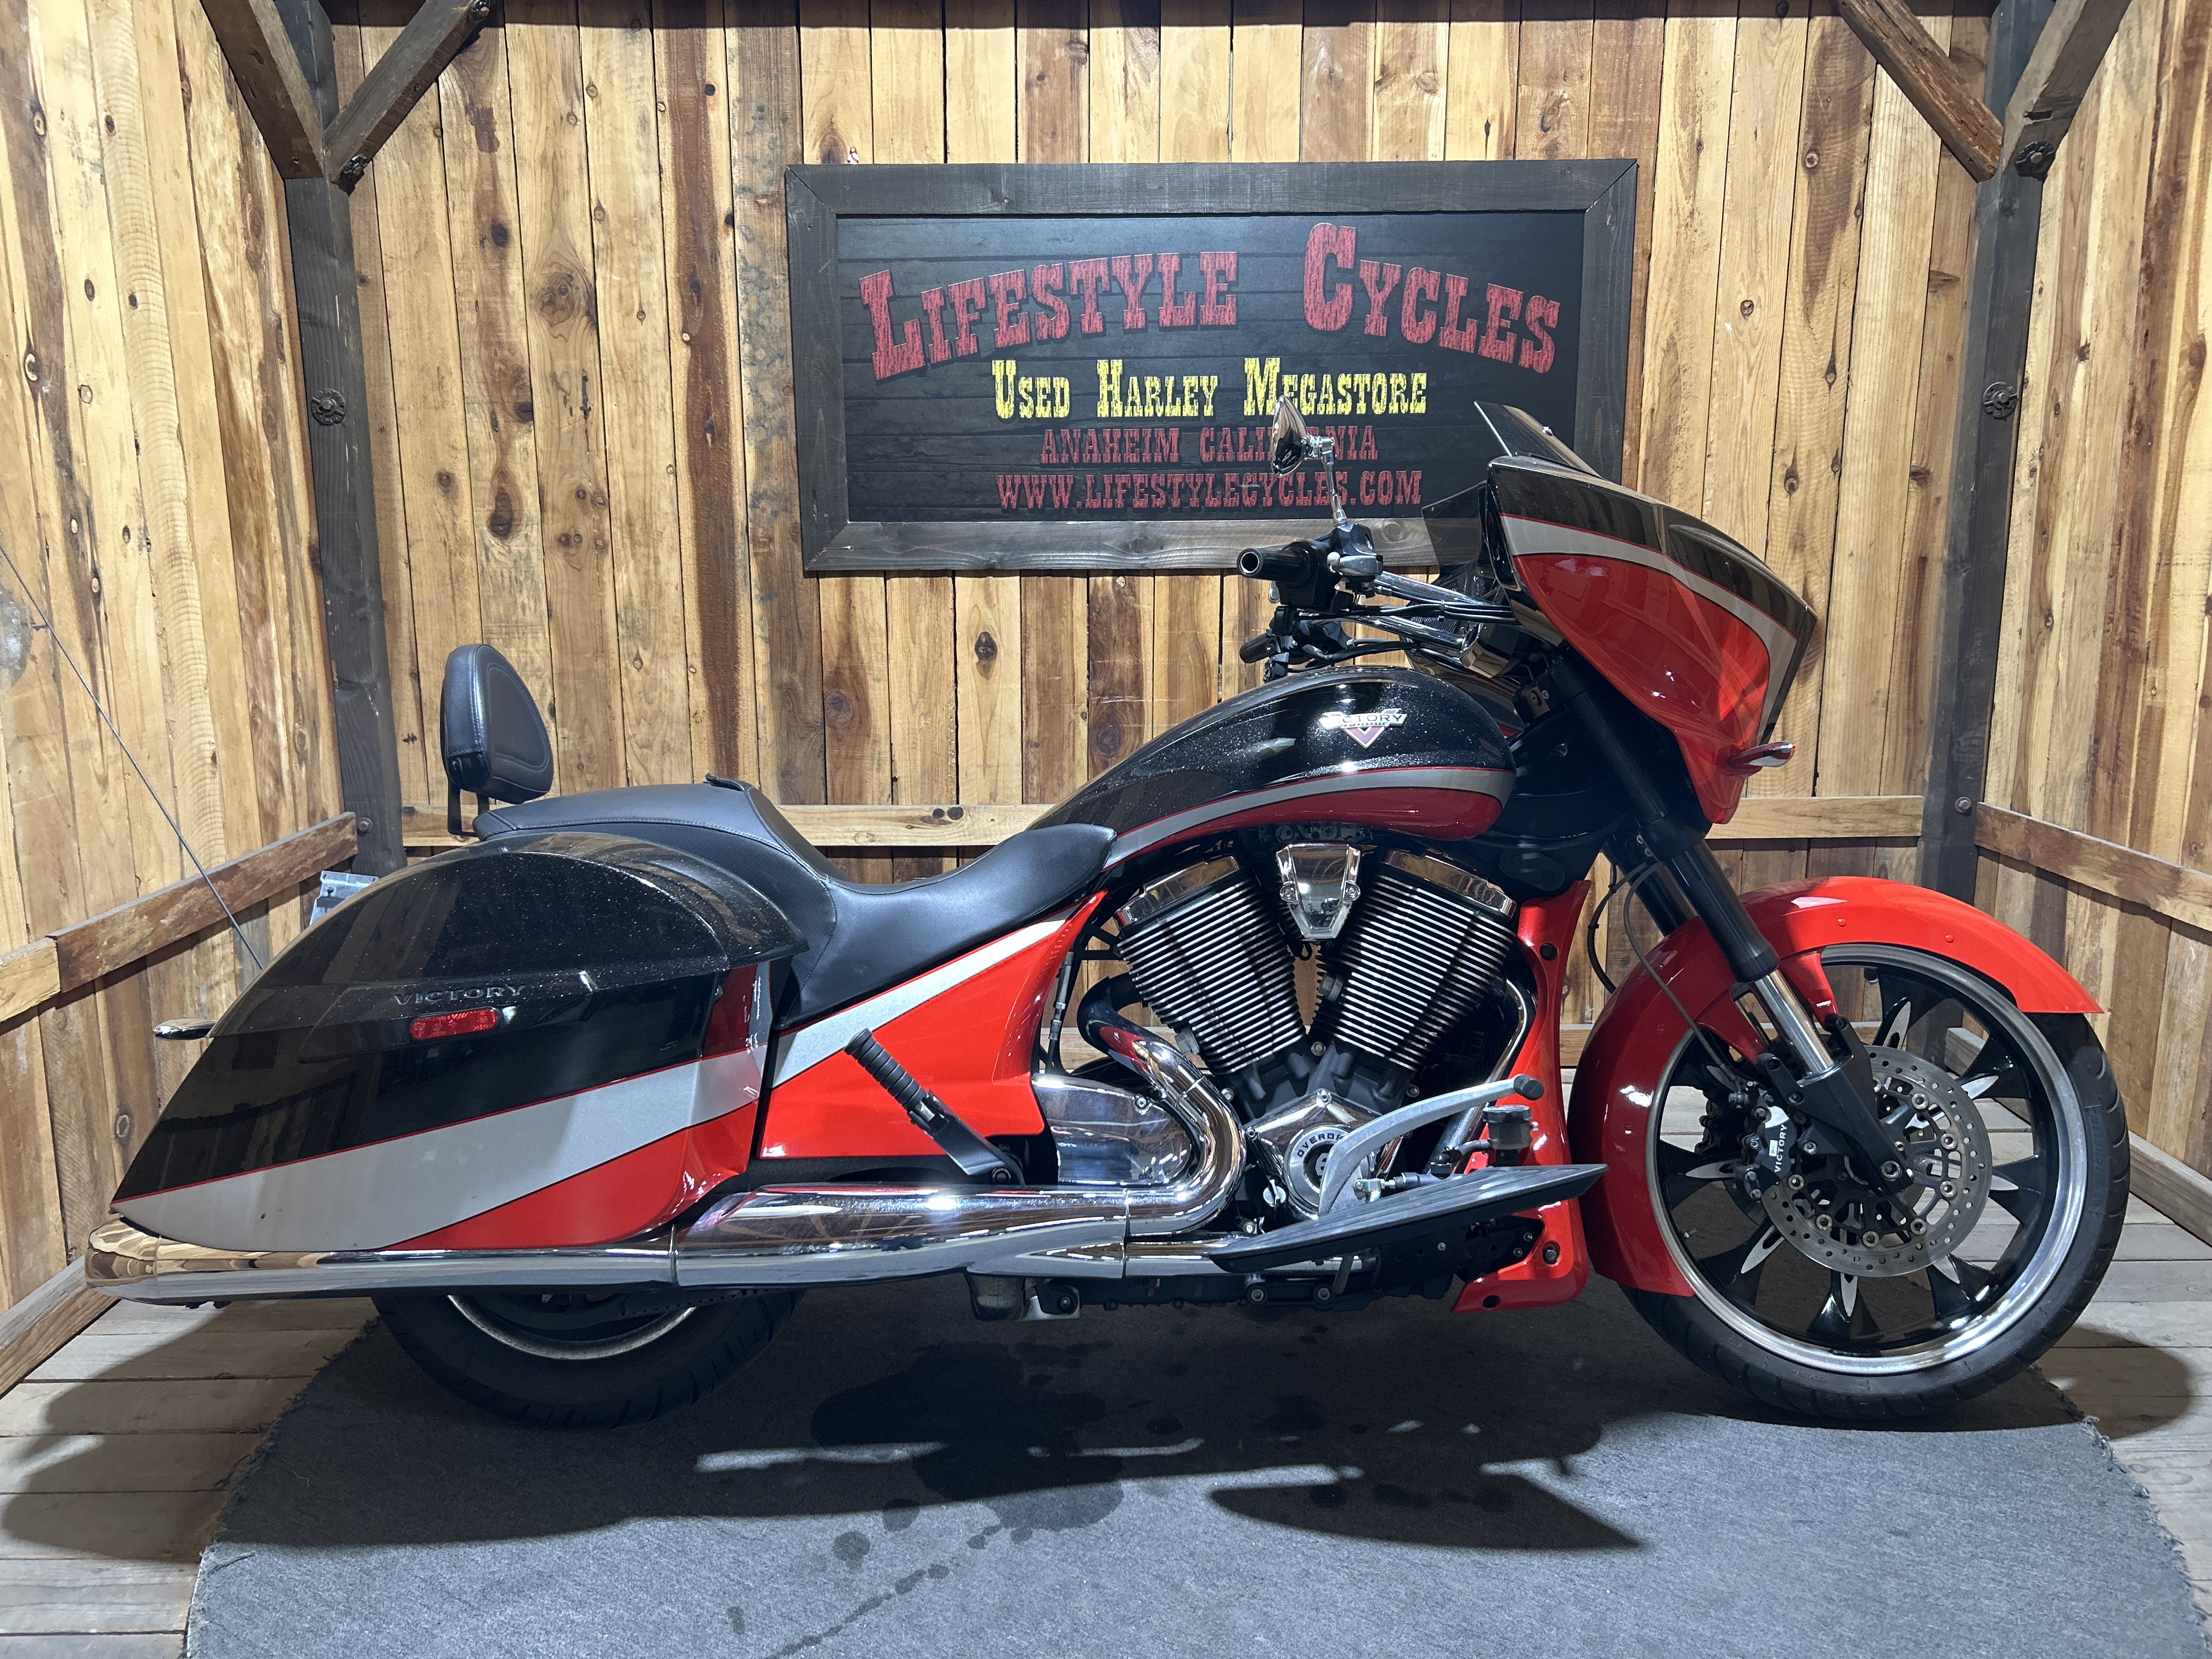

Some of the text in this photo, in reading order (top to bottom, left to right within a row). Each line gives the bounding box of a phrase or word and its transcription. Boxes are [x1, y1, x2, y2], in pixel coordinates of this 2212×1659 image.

[859, 222, 1561, 380] LIFESTYLE CYCLES
[992, 360, 1070, 419] USED
[1097, 359, 1218, 417] HARLEY
[1040, 425, 1378, 464] ANAHEIM CALINIA
[996, 471, 1422, 509] WWW.LIFESTYLECYCLES.COM
[393, 985, 527, 1005] VICTORY
[1774, 1124, 1787, 1172] VICTORY
